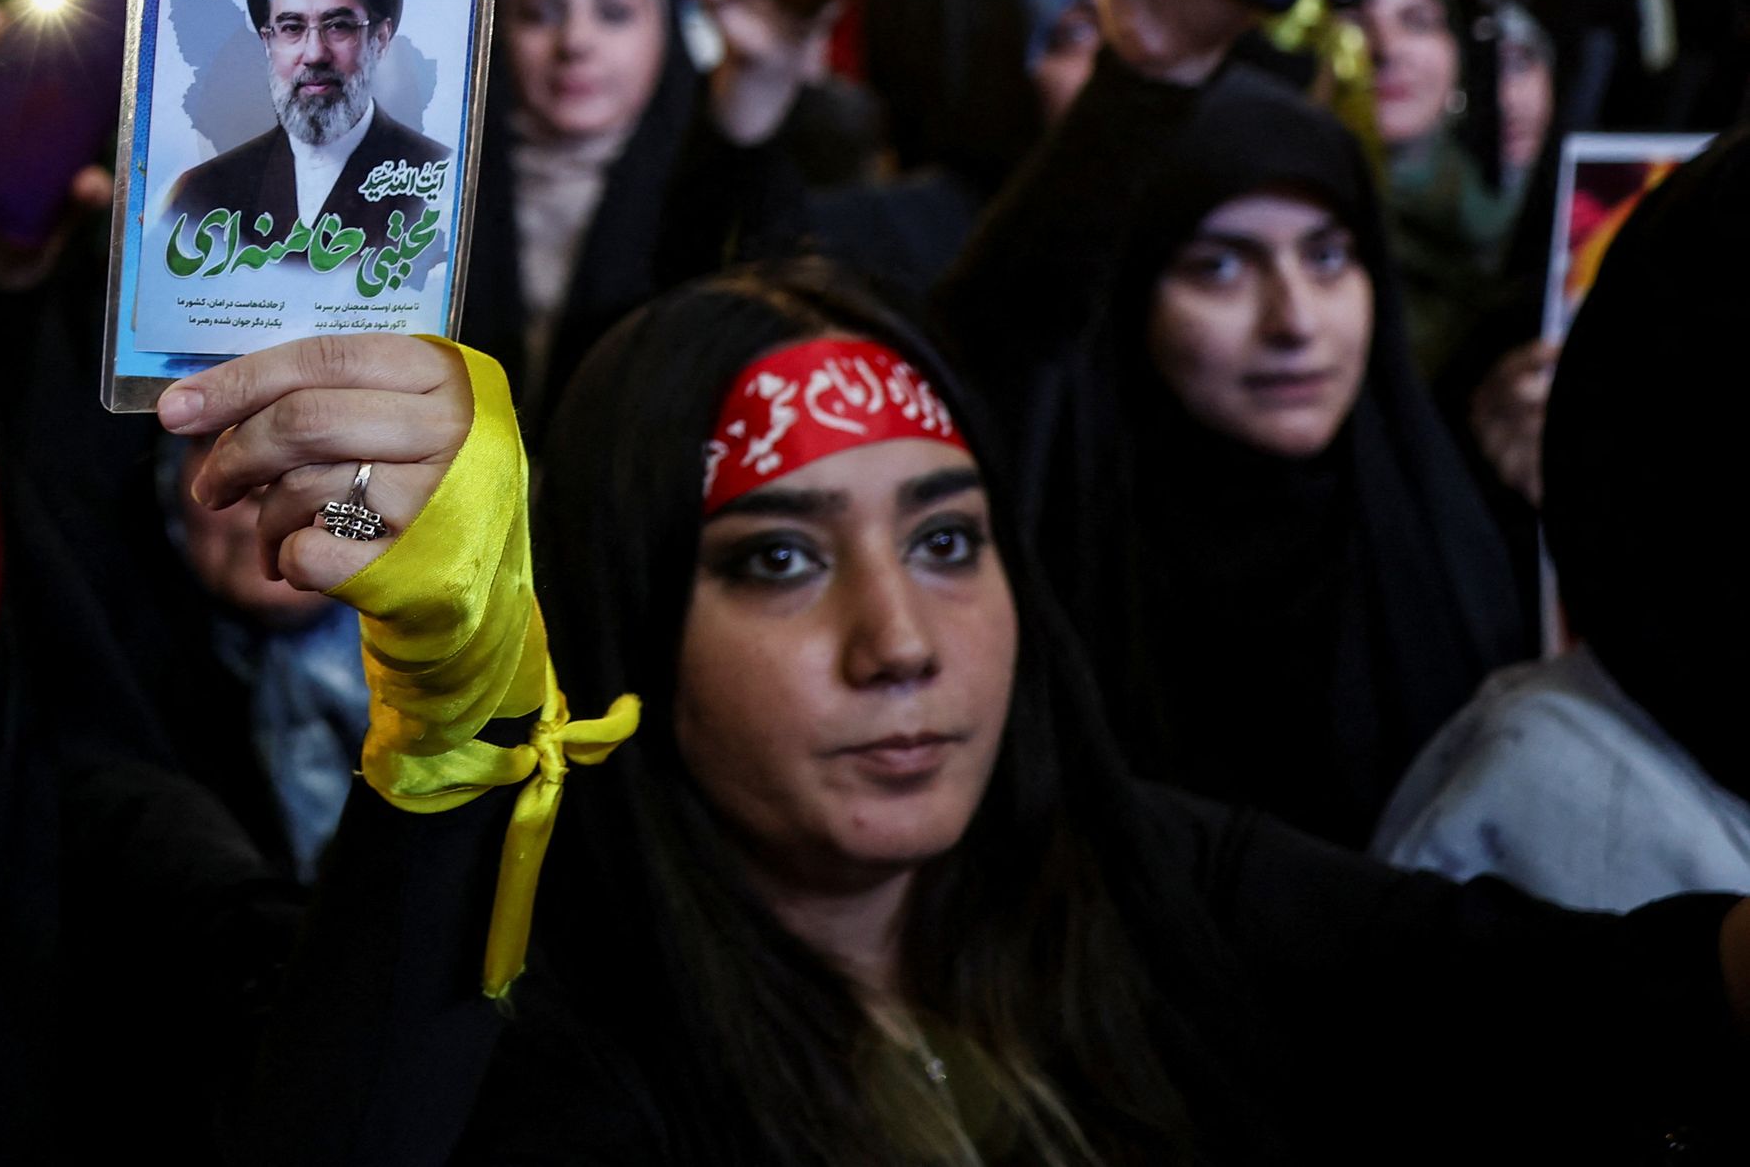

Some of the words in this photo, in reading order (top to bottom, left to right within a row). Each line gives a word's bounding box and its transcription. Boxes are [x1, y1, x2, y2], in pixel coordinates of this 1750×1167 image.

[166, 208, 366, 279] خامنه‌ای
[356, 208, 442, 300] مجتبی
[177, 297, 185, 306] ما
[185, 298, 206, 308] کشور
[225, 301, 234, 309] در
[279, 301, 285, 311] از
[314, 302, 321, 310] ما
[333, 305, 341, 313] بر
[342, 303, 370, 314] همچنان
[371, 303, 390, 313] اوست
[189, 315, 196, 323] ما
[196, 316, 213, 326] رهبر
[214, 317, 231, 325] شده
[232, 316, 251, 328] جوان
[251, 317, 264, 328] دگر
[400, 320, 406, 328] تا
[315, 321, 328, 330] دید
[329, 320, 350, 330] نتواند
[373, 320, 388, 330] شود
[389, 320, 401, 330] کور
